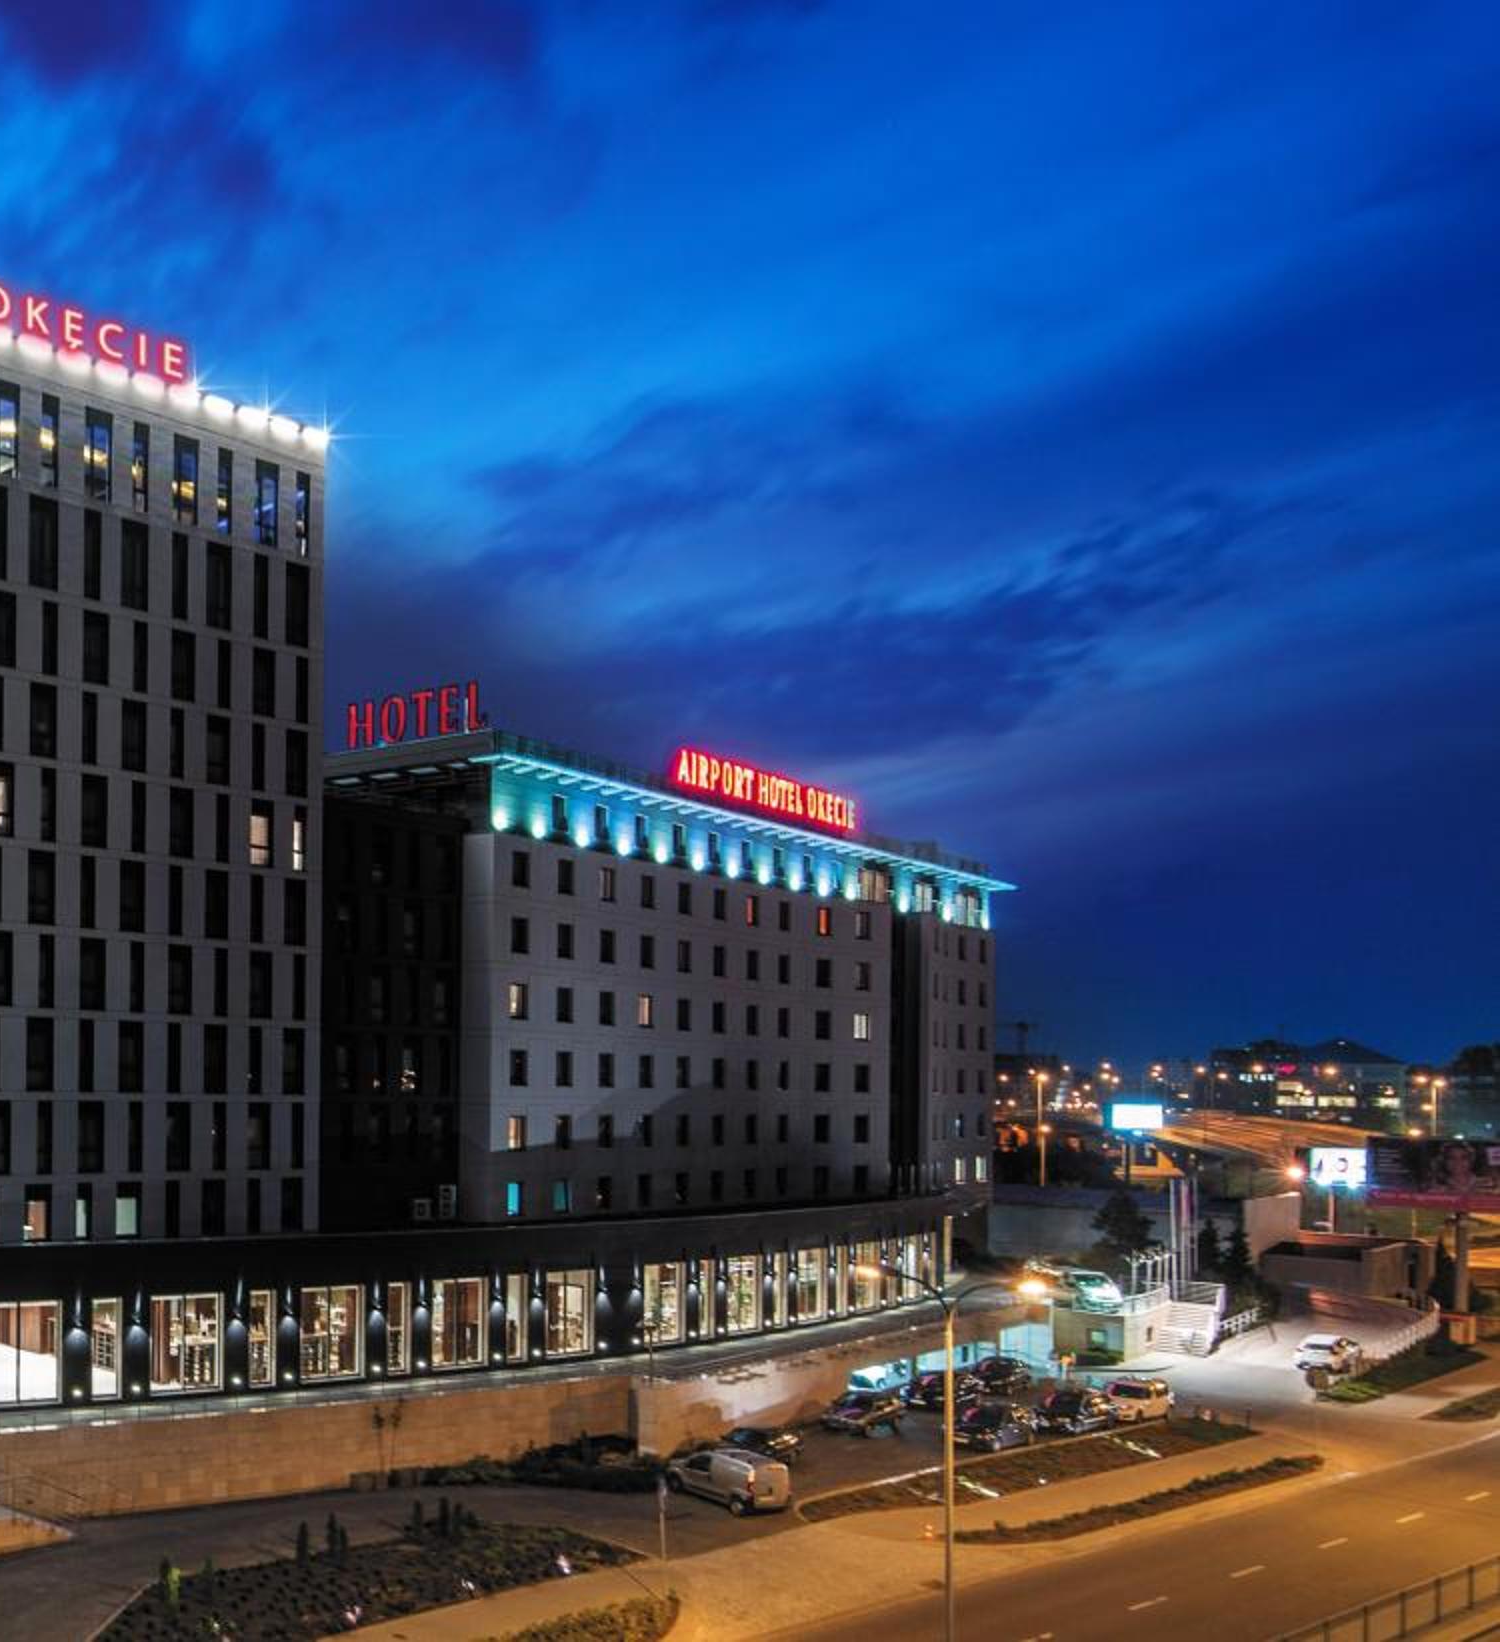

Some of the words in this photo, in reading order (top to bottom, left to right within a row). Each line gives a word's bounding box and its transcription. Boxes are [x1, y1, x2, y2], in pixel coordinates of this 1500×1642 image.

[347, 680, 484, 749] HOTEL
[676, 748, 755, 801] AIRPORT
[758, 773, 804, 815] HOTEL
